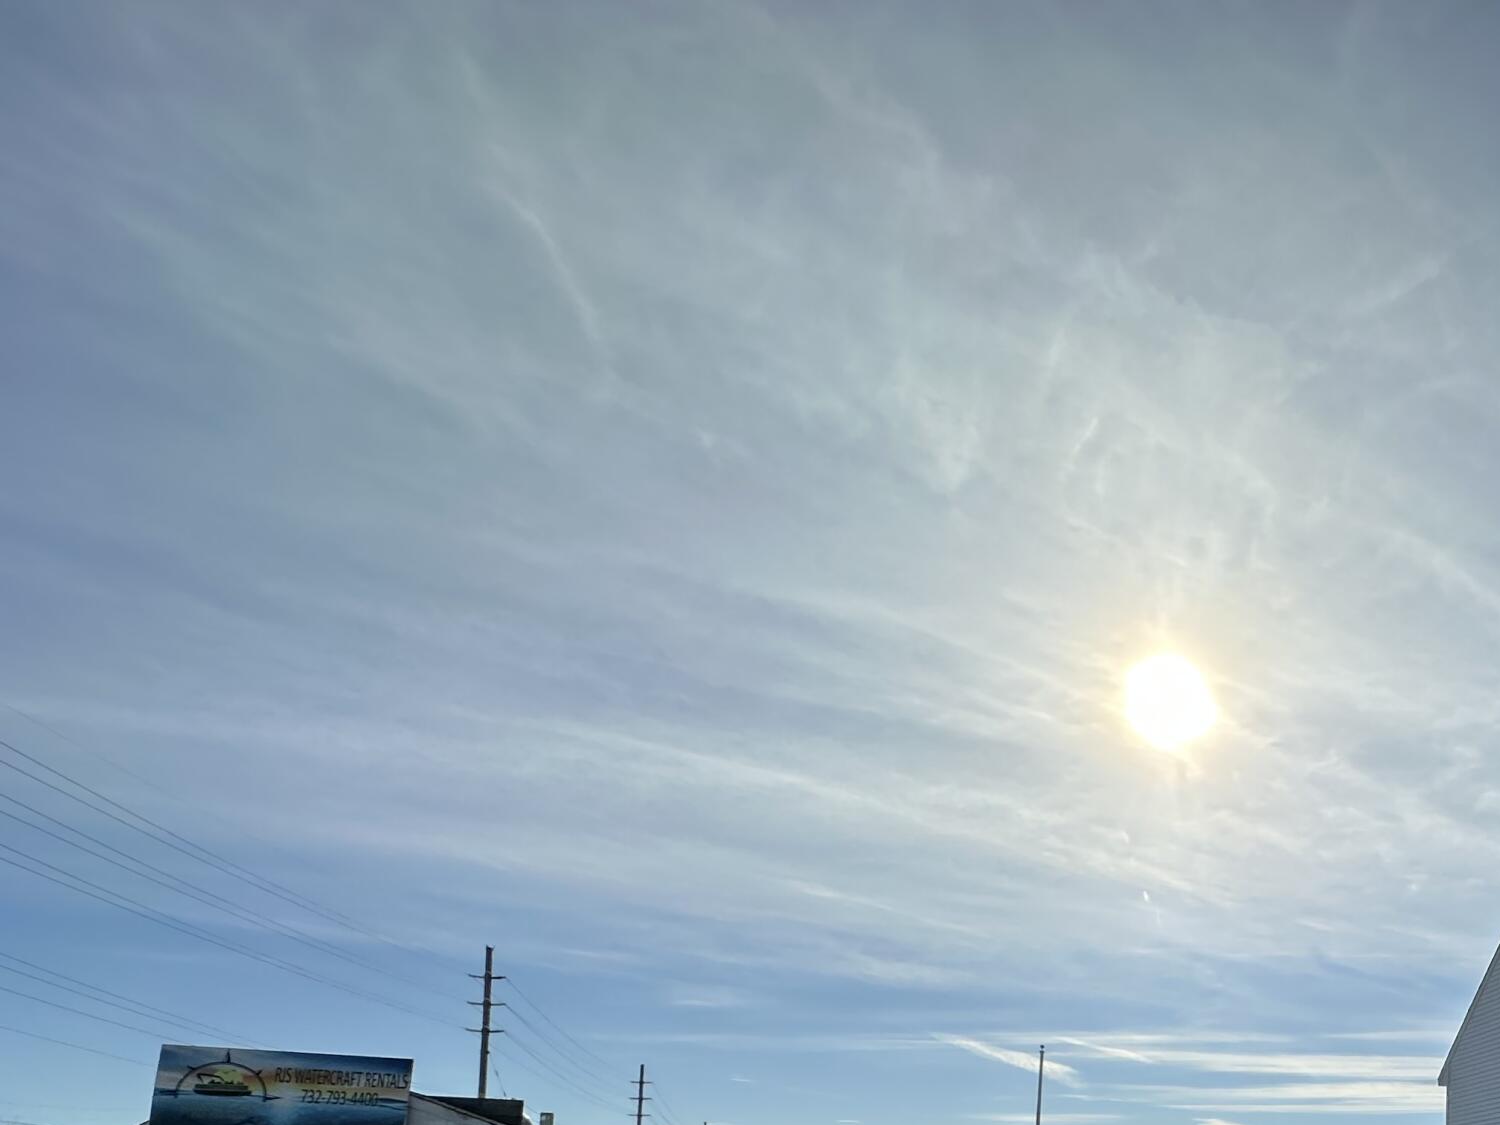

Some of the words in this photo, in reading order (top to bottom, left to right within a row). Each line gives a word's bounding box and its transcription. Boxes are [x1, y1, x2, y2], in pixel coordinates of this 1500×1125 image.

[275, 1066, 292, 1082] RJS
[294, 1068, 362, 1087] WATERCRAFT
[365, 1073, 408, 1089] RENTALS
[301, 1088, 379, 1107] 732-793-4400
